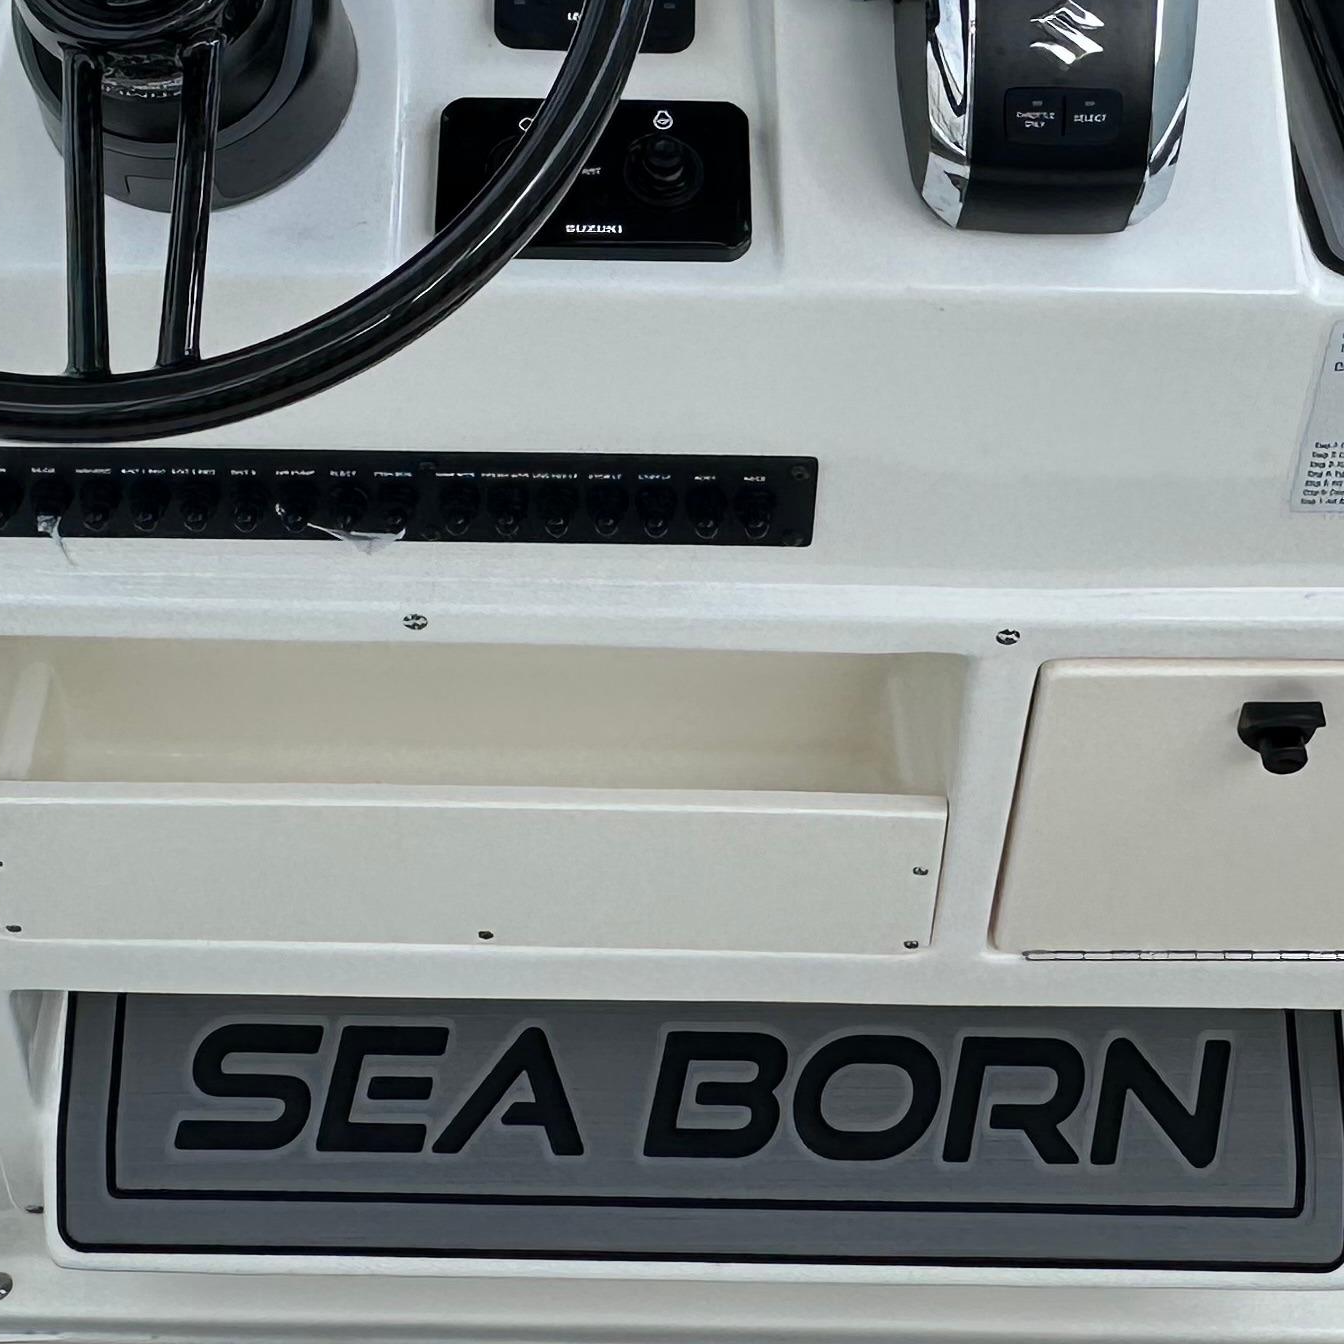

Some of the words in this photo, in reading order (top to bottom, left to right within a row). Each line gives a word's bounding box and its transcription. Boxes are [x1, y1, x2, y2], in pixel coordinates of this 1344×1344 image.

[565, 224, 623, 234] SUZUKI
[172, 1022, 585, 1158] SEA
[642, 1029, 1232, 1170] BORN
